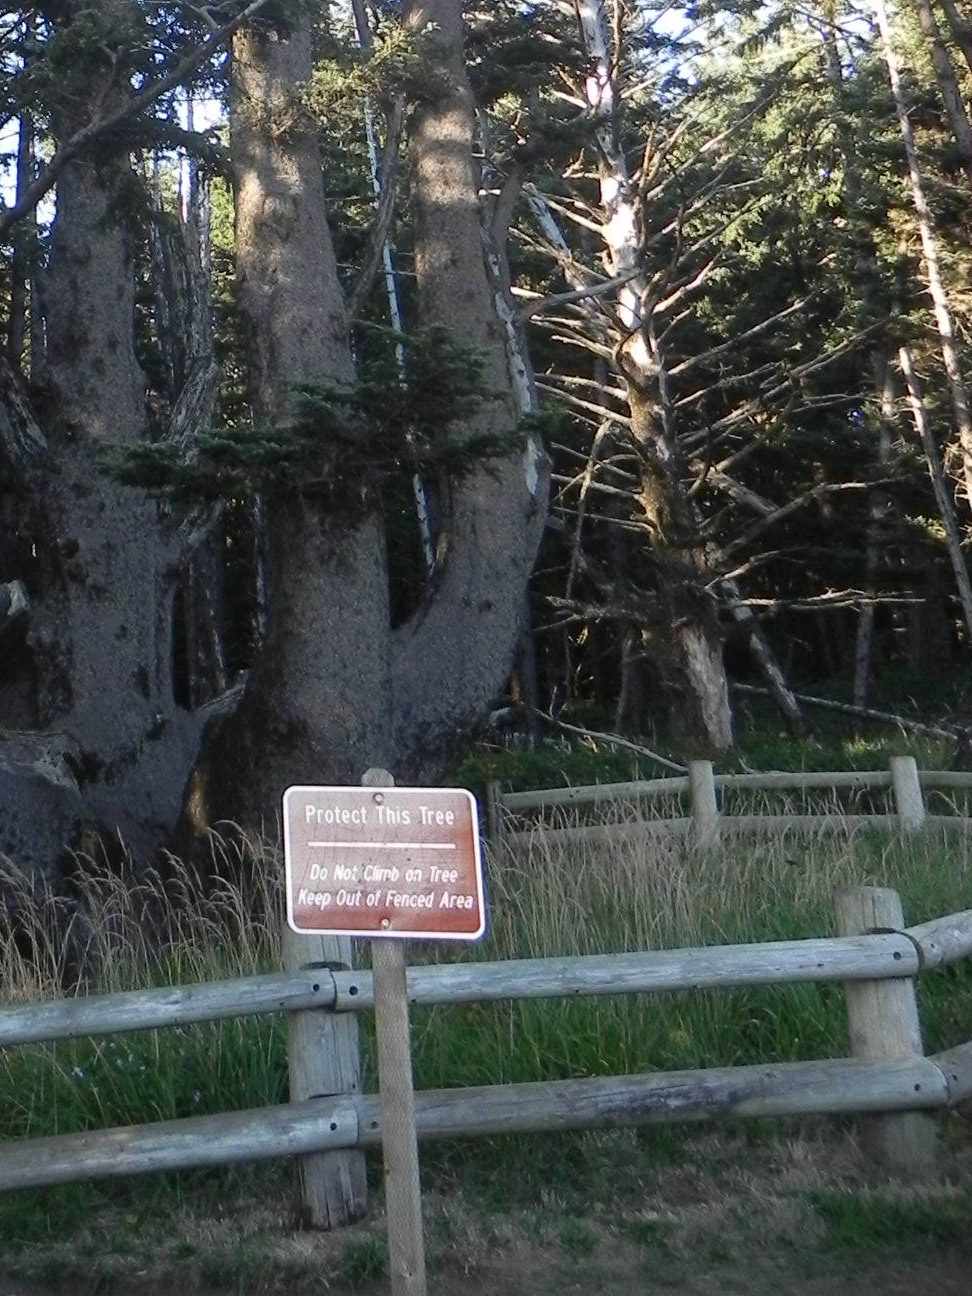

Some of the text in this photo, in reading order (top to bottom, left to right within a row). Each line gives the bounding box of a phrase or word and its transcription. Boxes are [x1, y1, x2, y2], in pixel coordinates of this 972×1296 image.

[305, 805, 455, 825] Protect This Tree
[310, 864, 459, 883] Do Not Climb on Tree
[298, 888, 474, 911] Keep Out of Fenced Area
